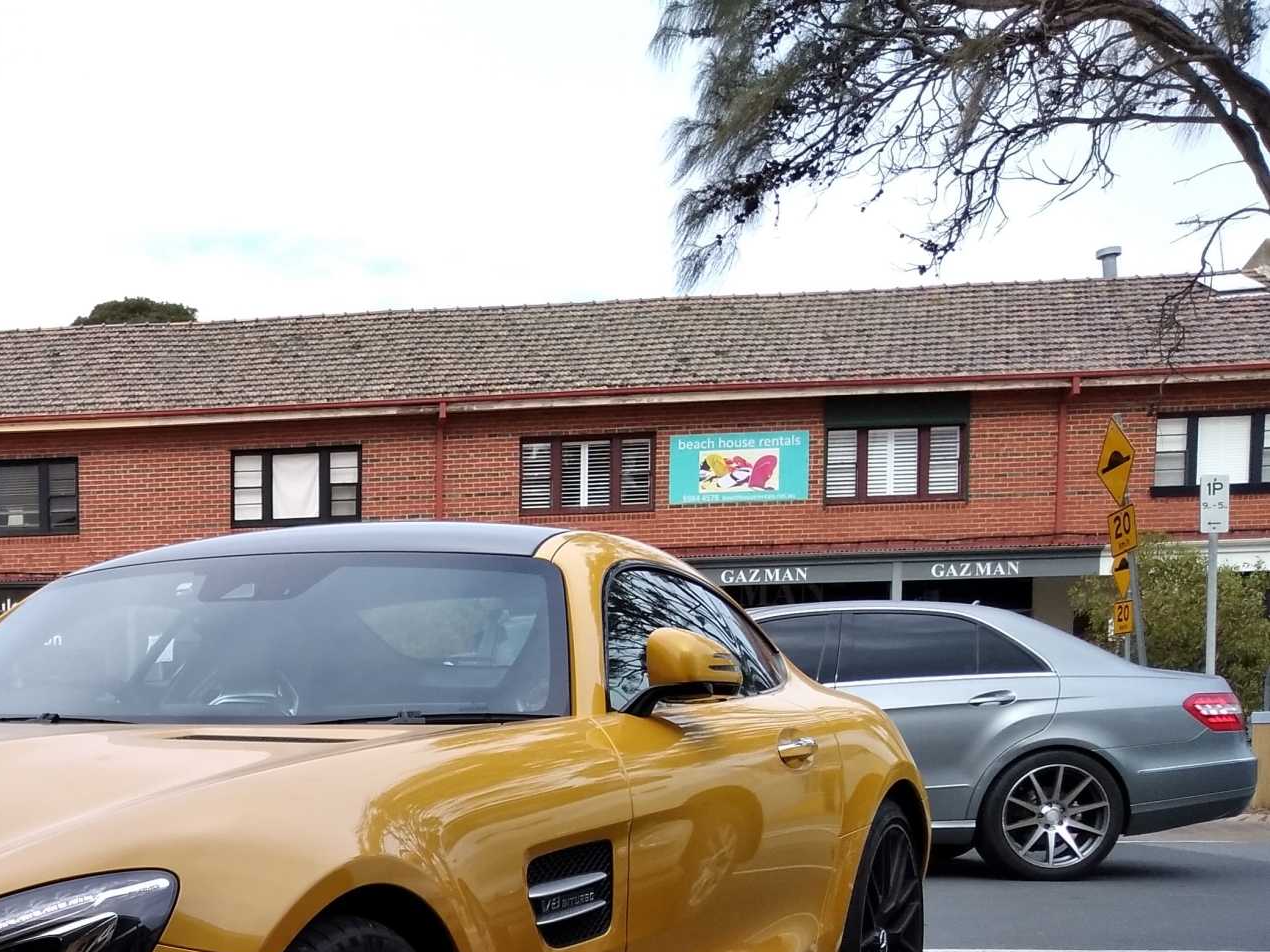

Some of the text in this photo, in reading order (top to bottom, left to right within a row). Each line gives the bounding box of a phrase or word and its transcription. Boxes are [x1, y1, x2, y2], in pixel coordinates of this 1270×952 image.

[678, 434, 801, 450] beach house rentals
[1206, 482, 1224, 496] 1P
[1113, 511, 1131, 539] 20
[1117, 604, 1130, 622] 20
